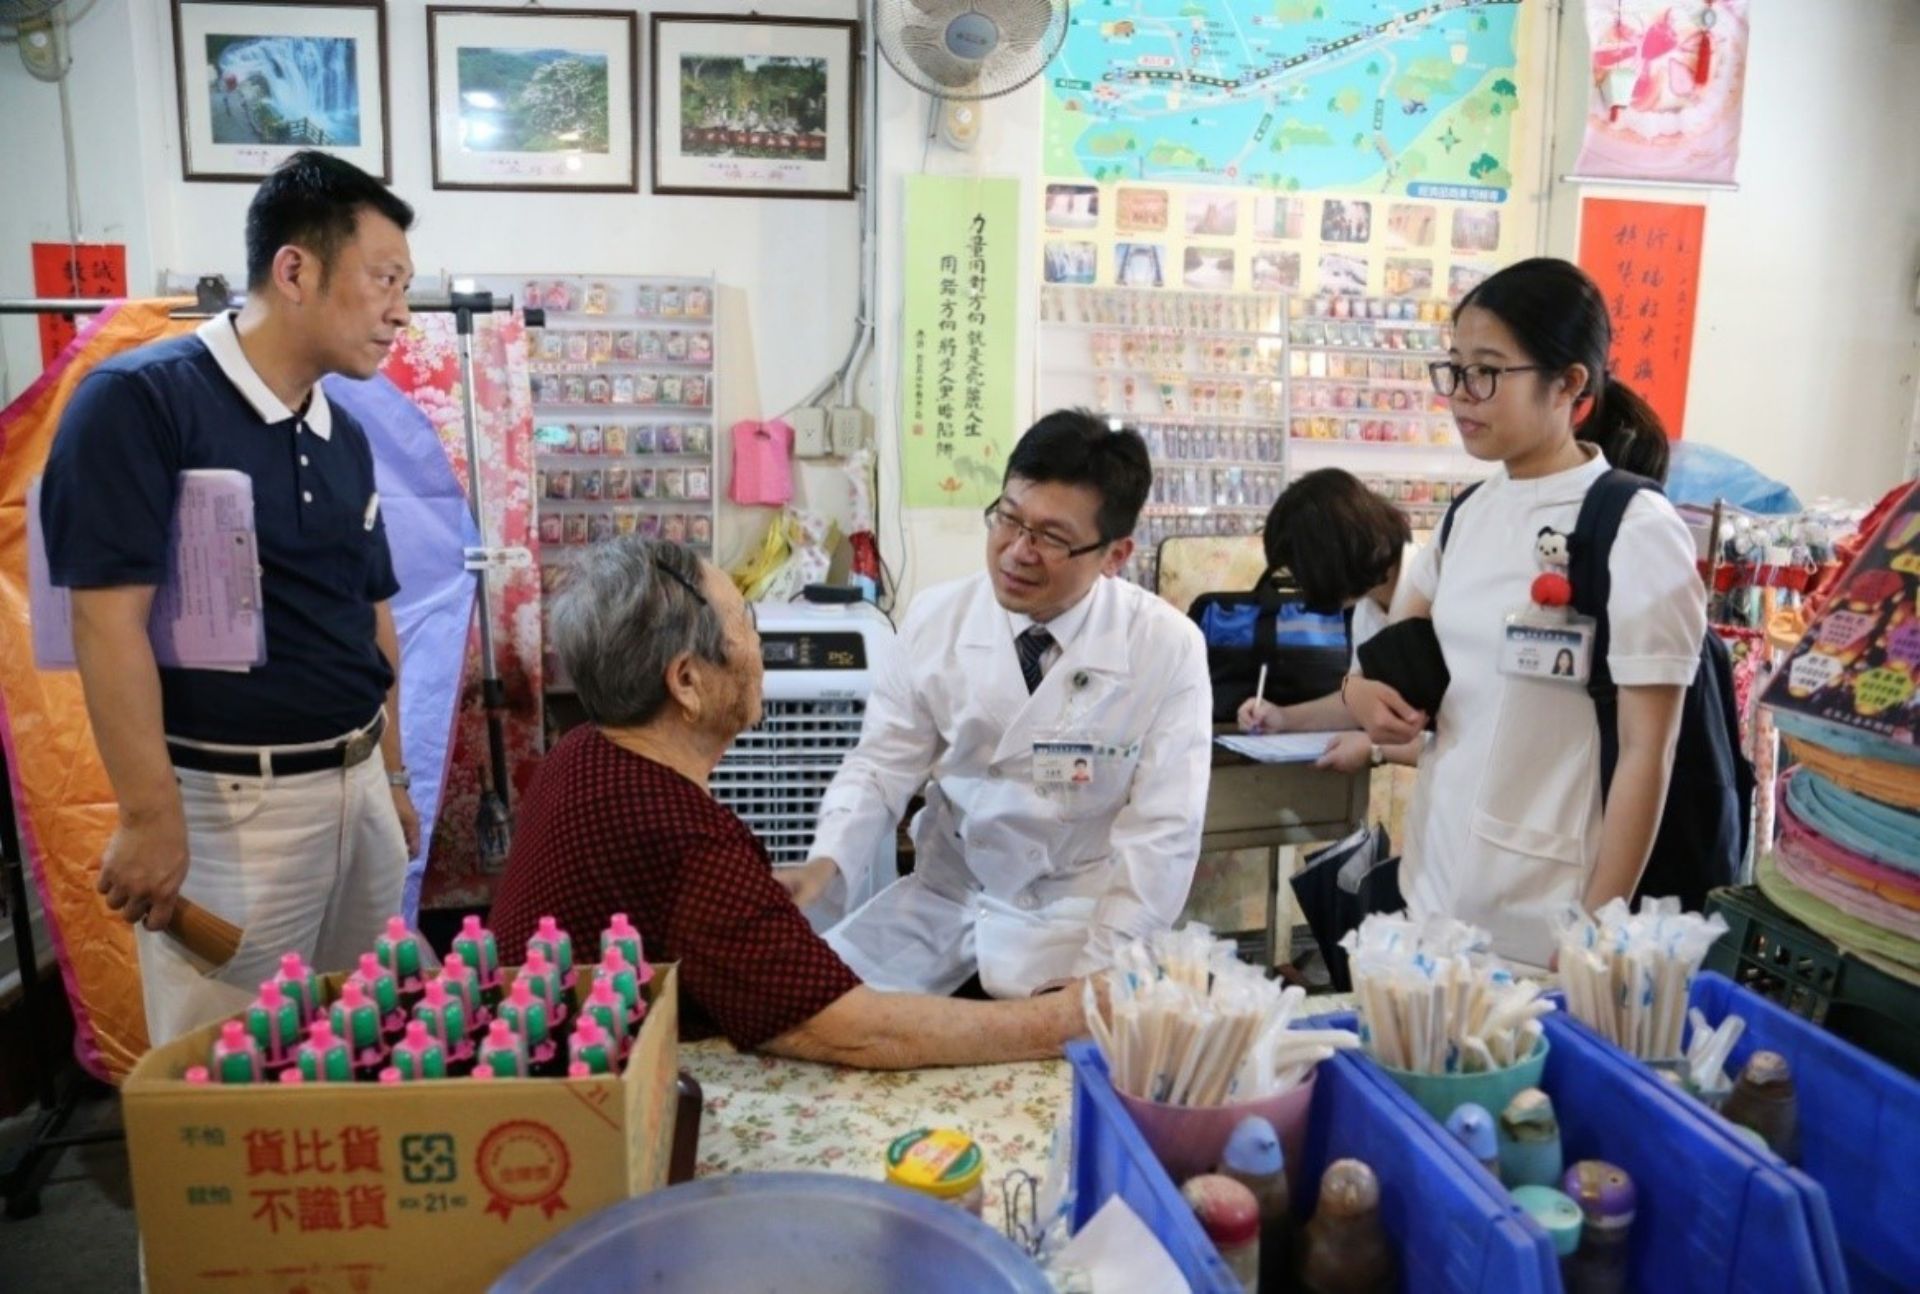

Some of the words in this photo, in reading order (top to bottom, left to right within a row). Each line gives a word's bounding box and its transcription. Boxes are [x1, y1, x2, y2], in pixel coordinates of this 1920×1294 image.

[243, 1124, 384, 1176] 貨比貨
[249, 1183, 389, 1234] 不識貨
[425, 1194, 448, 1212] 21
